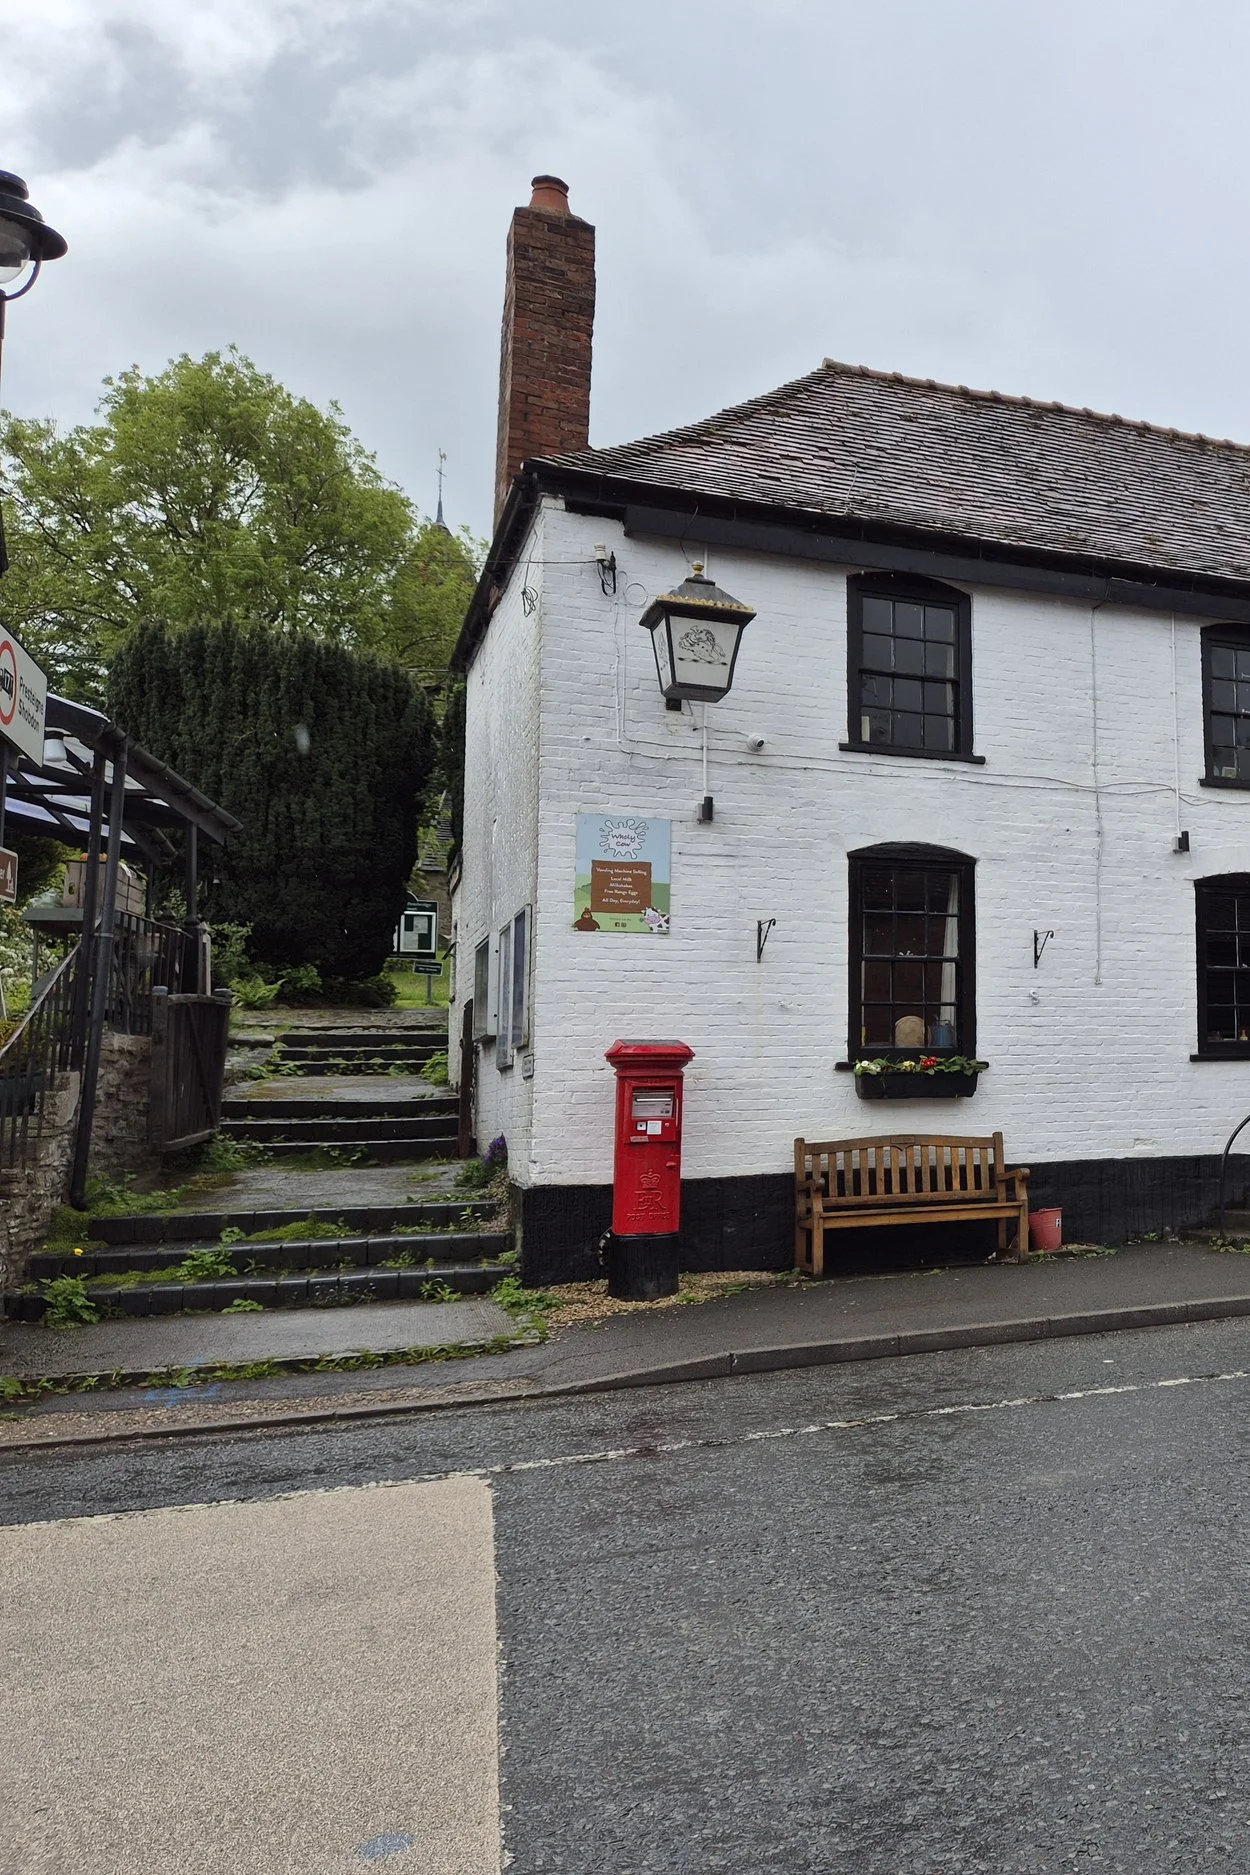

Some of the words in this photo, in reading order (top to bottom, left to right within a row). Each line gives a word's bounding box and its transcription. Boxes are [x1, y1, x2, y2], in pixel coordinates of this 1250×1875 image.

[20, 675, 43, 715] Presteigne
[18, 698, 39, 733] Shobdon
[611, 833, 636, 843] Wholy
